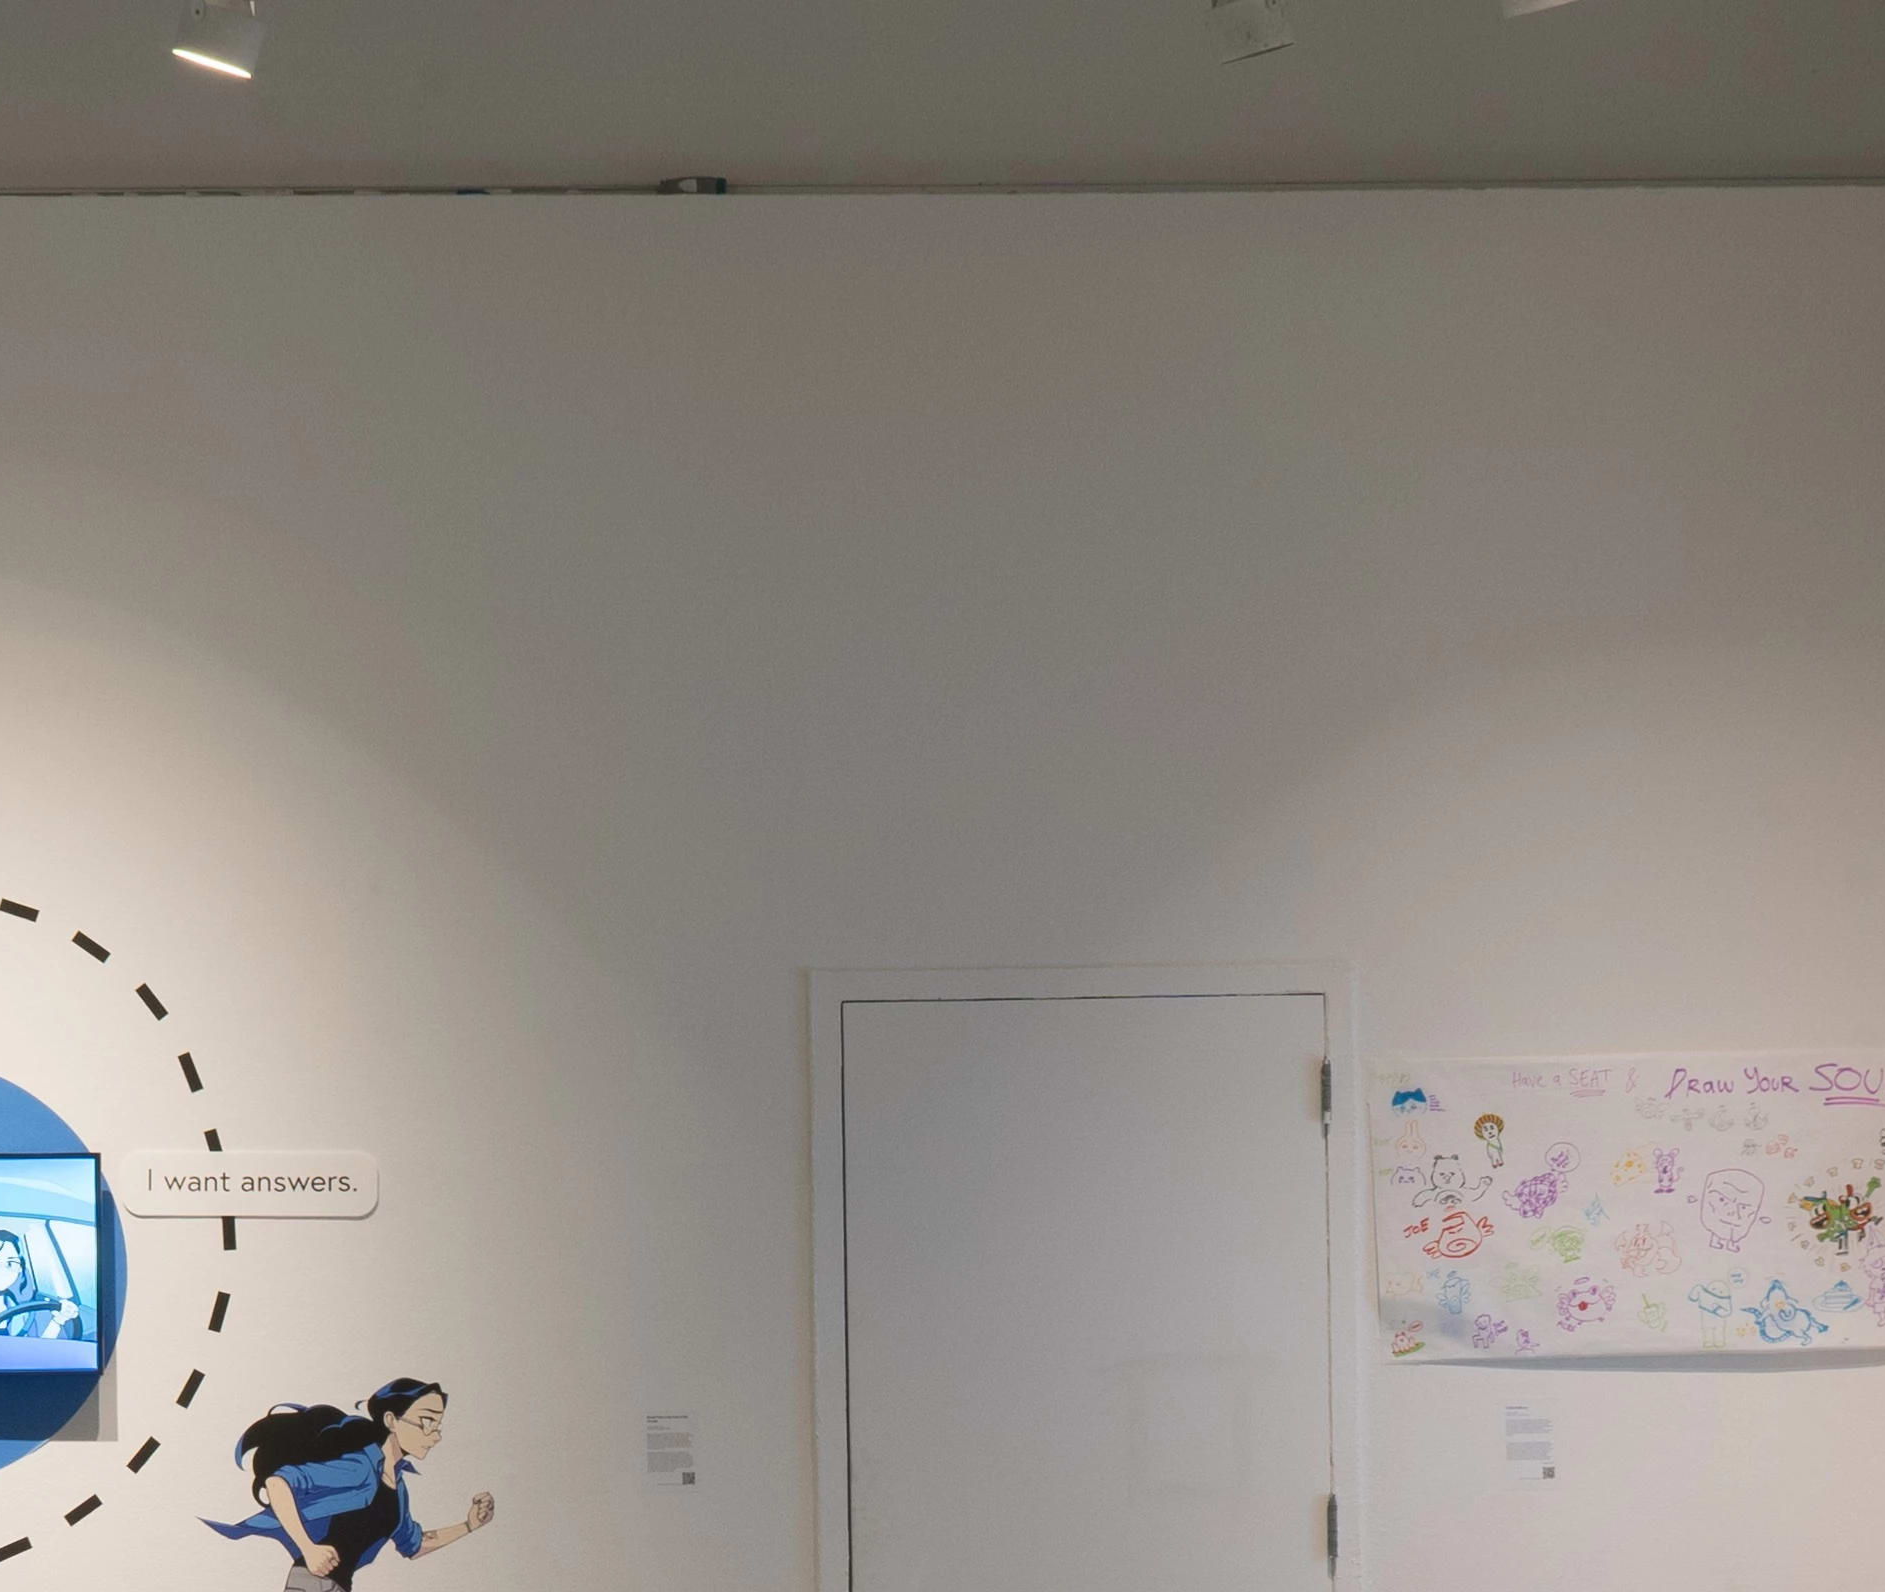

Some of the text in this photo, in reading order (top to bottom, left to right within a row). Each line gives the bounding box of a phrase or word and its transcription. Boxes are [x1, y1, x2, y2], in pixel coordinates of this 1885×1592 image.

[1512, 1070, 1547, 1089] Have
[1552, 1076, 1562, 1086] a
[1568, 1067, 1613, 1088] SEAT
[1625, 1066, 1639, 1094] &
[147, 1168, 358, 1193] I want answers.
[1402, 1216, 1430, 1239] JOE
